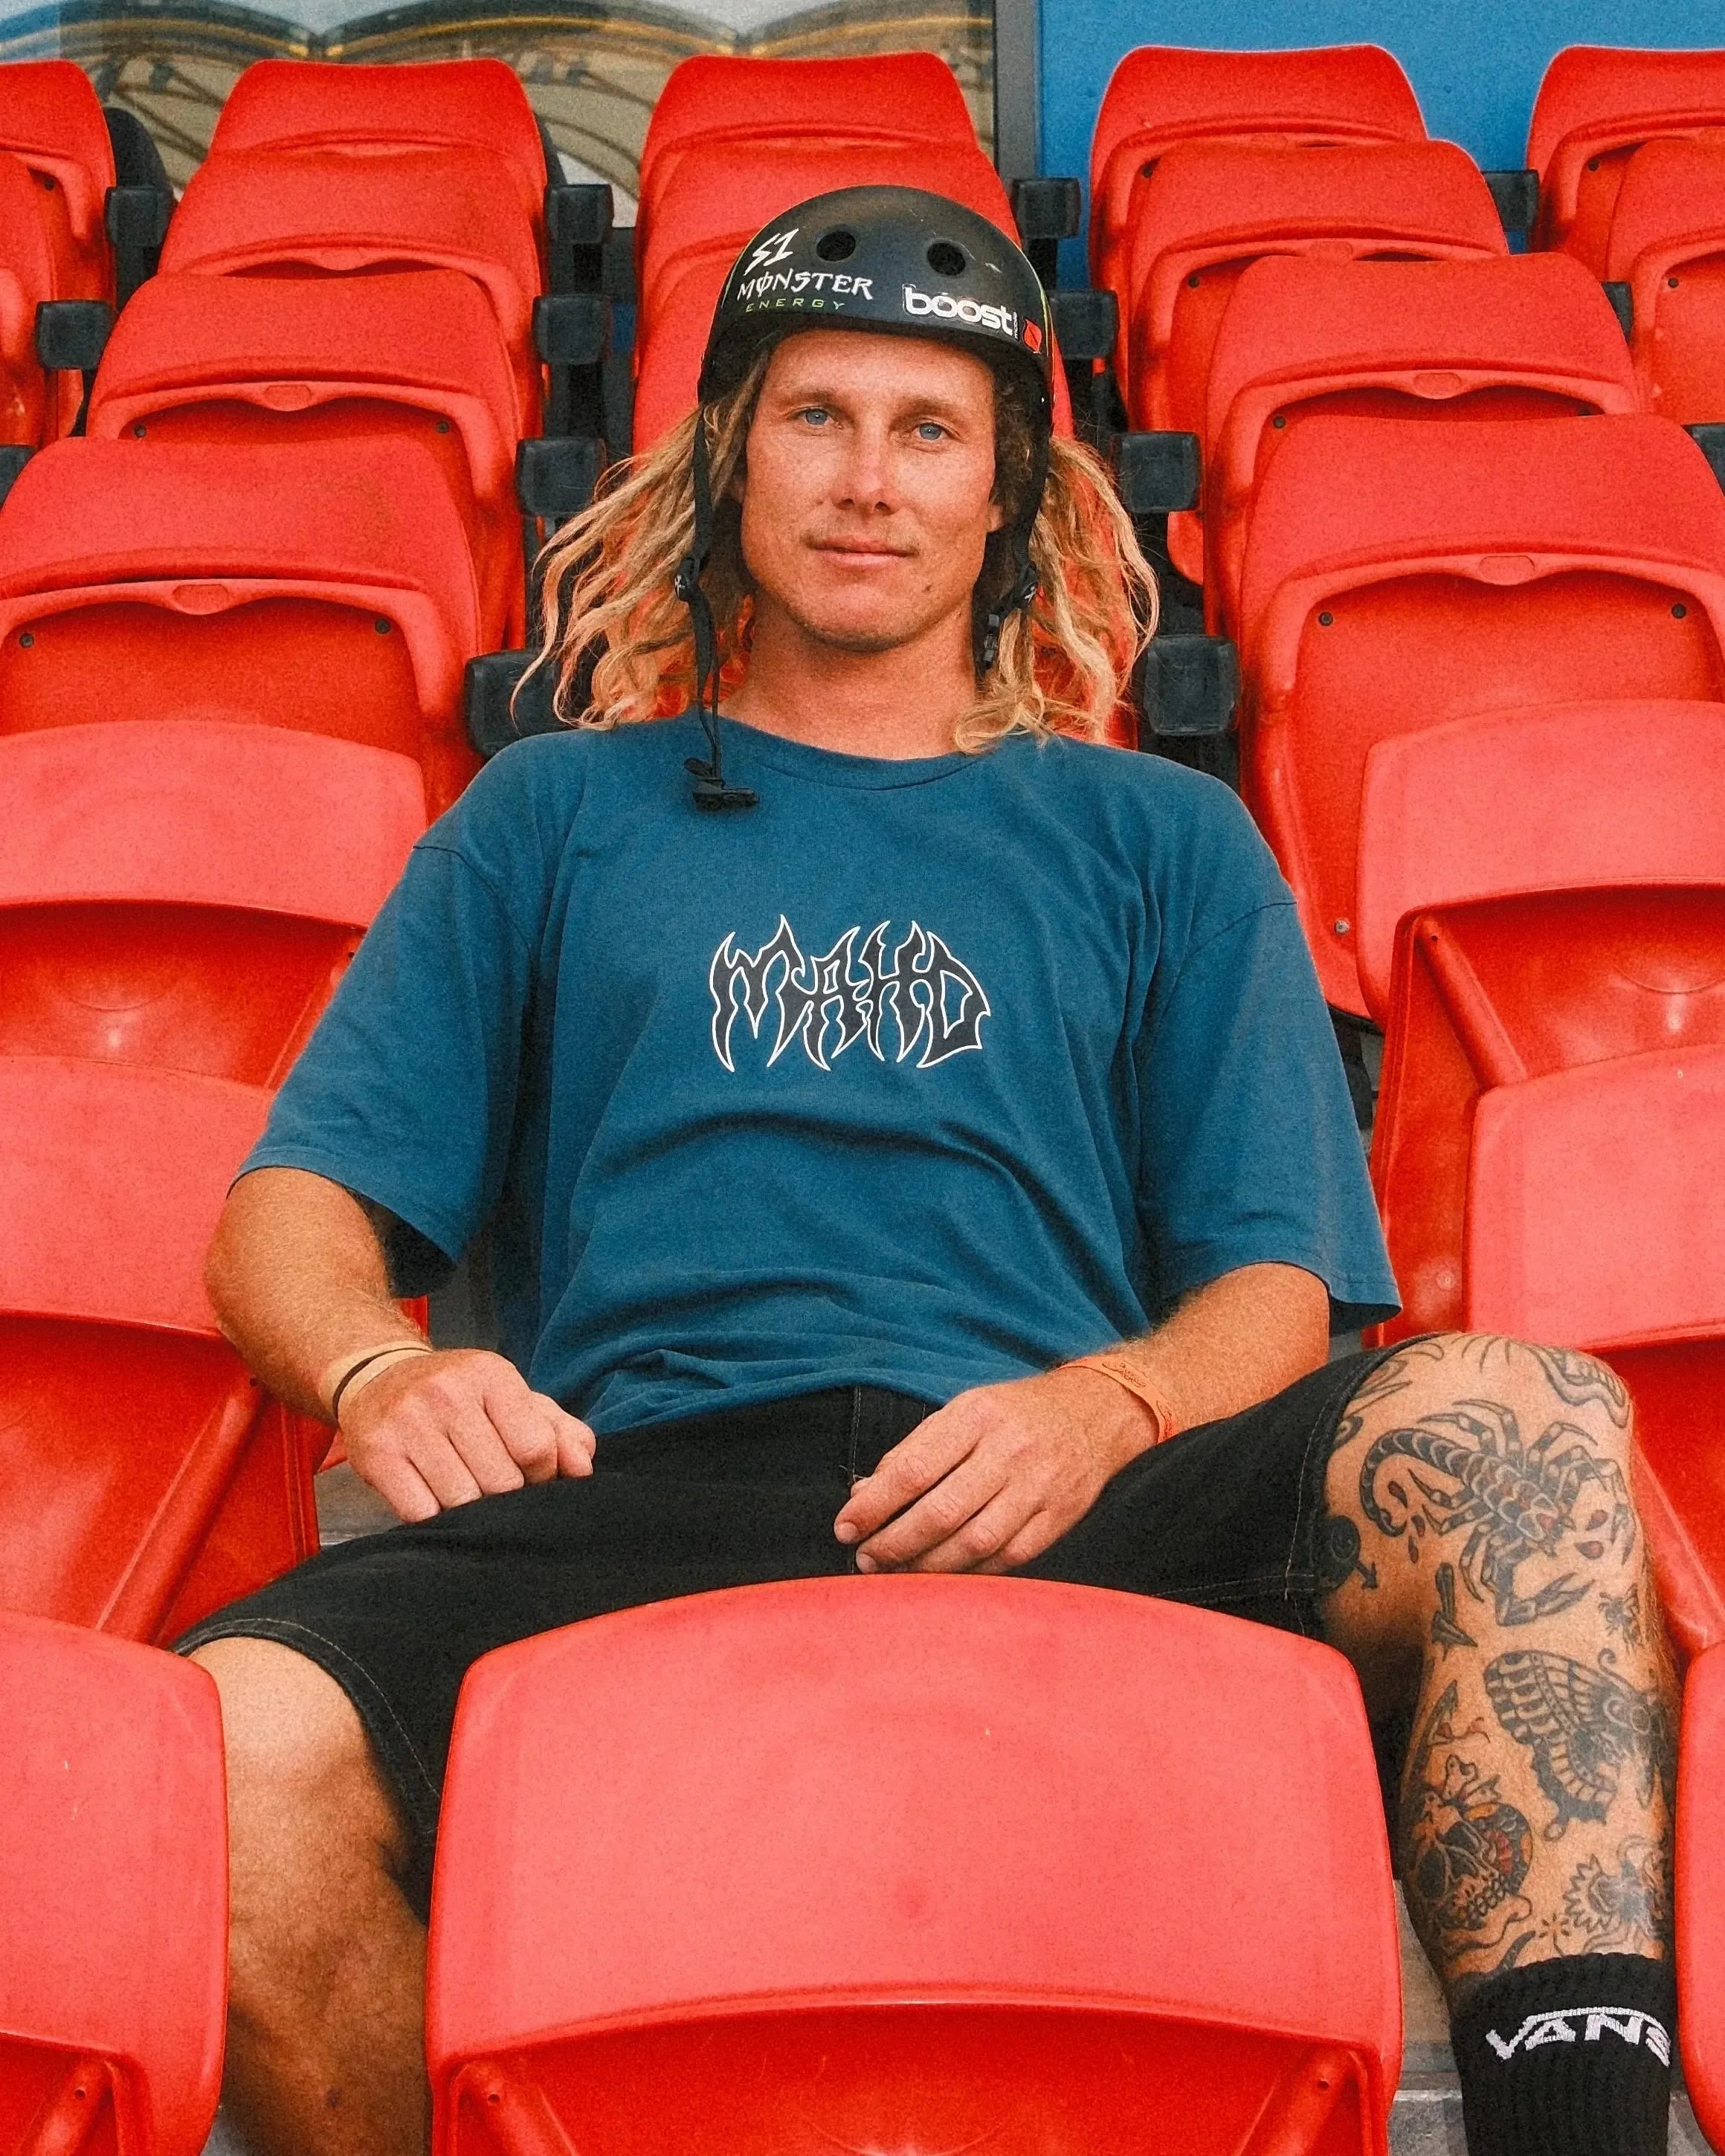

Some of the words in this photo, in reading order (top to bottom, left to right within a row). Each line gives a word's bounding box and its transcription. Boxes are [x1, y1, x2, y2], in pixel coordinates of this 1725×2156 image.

[745, 297, 845, 313] ENERGY
[905, 285, 1013, 336] boost
[1485, 2006, 1671, 2068] VANS
